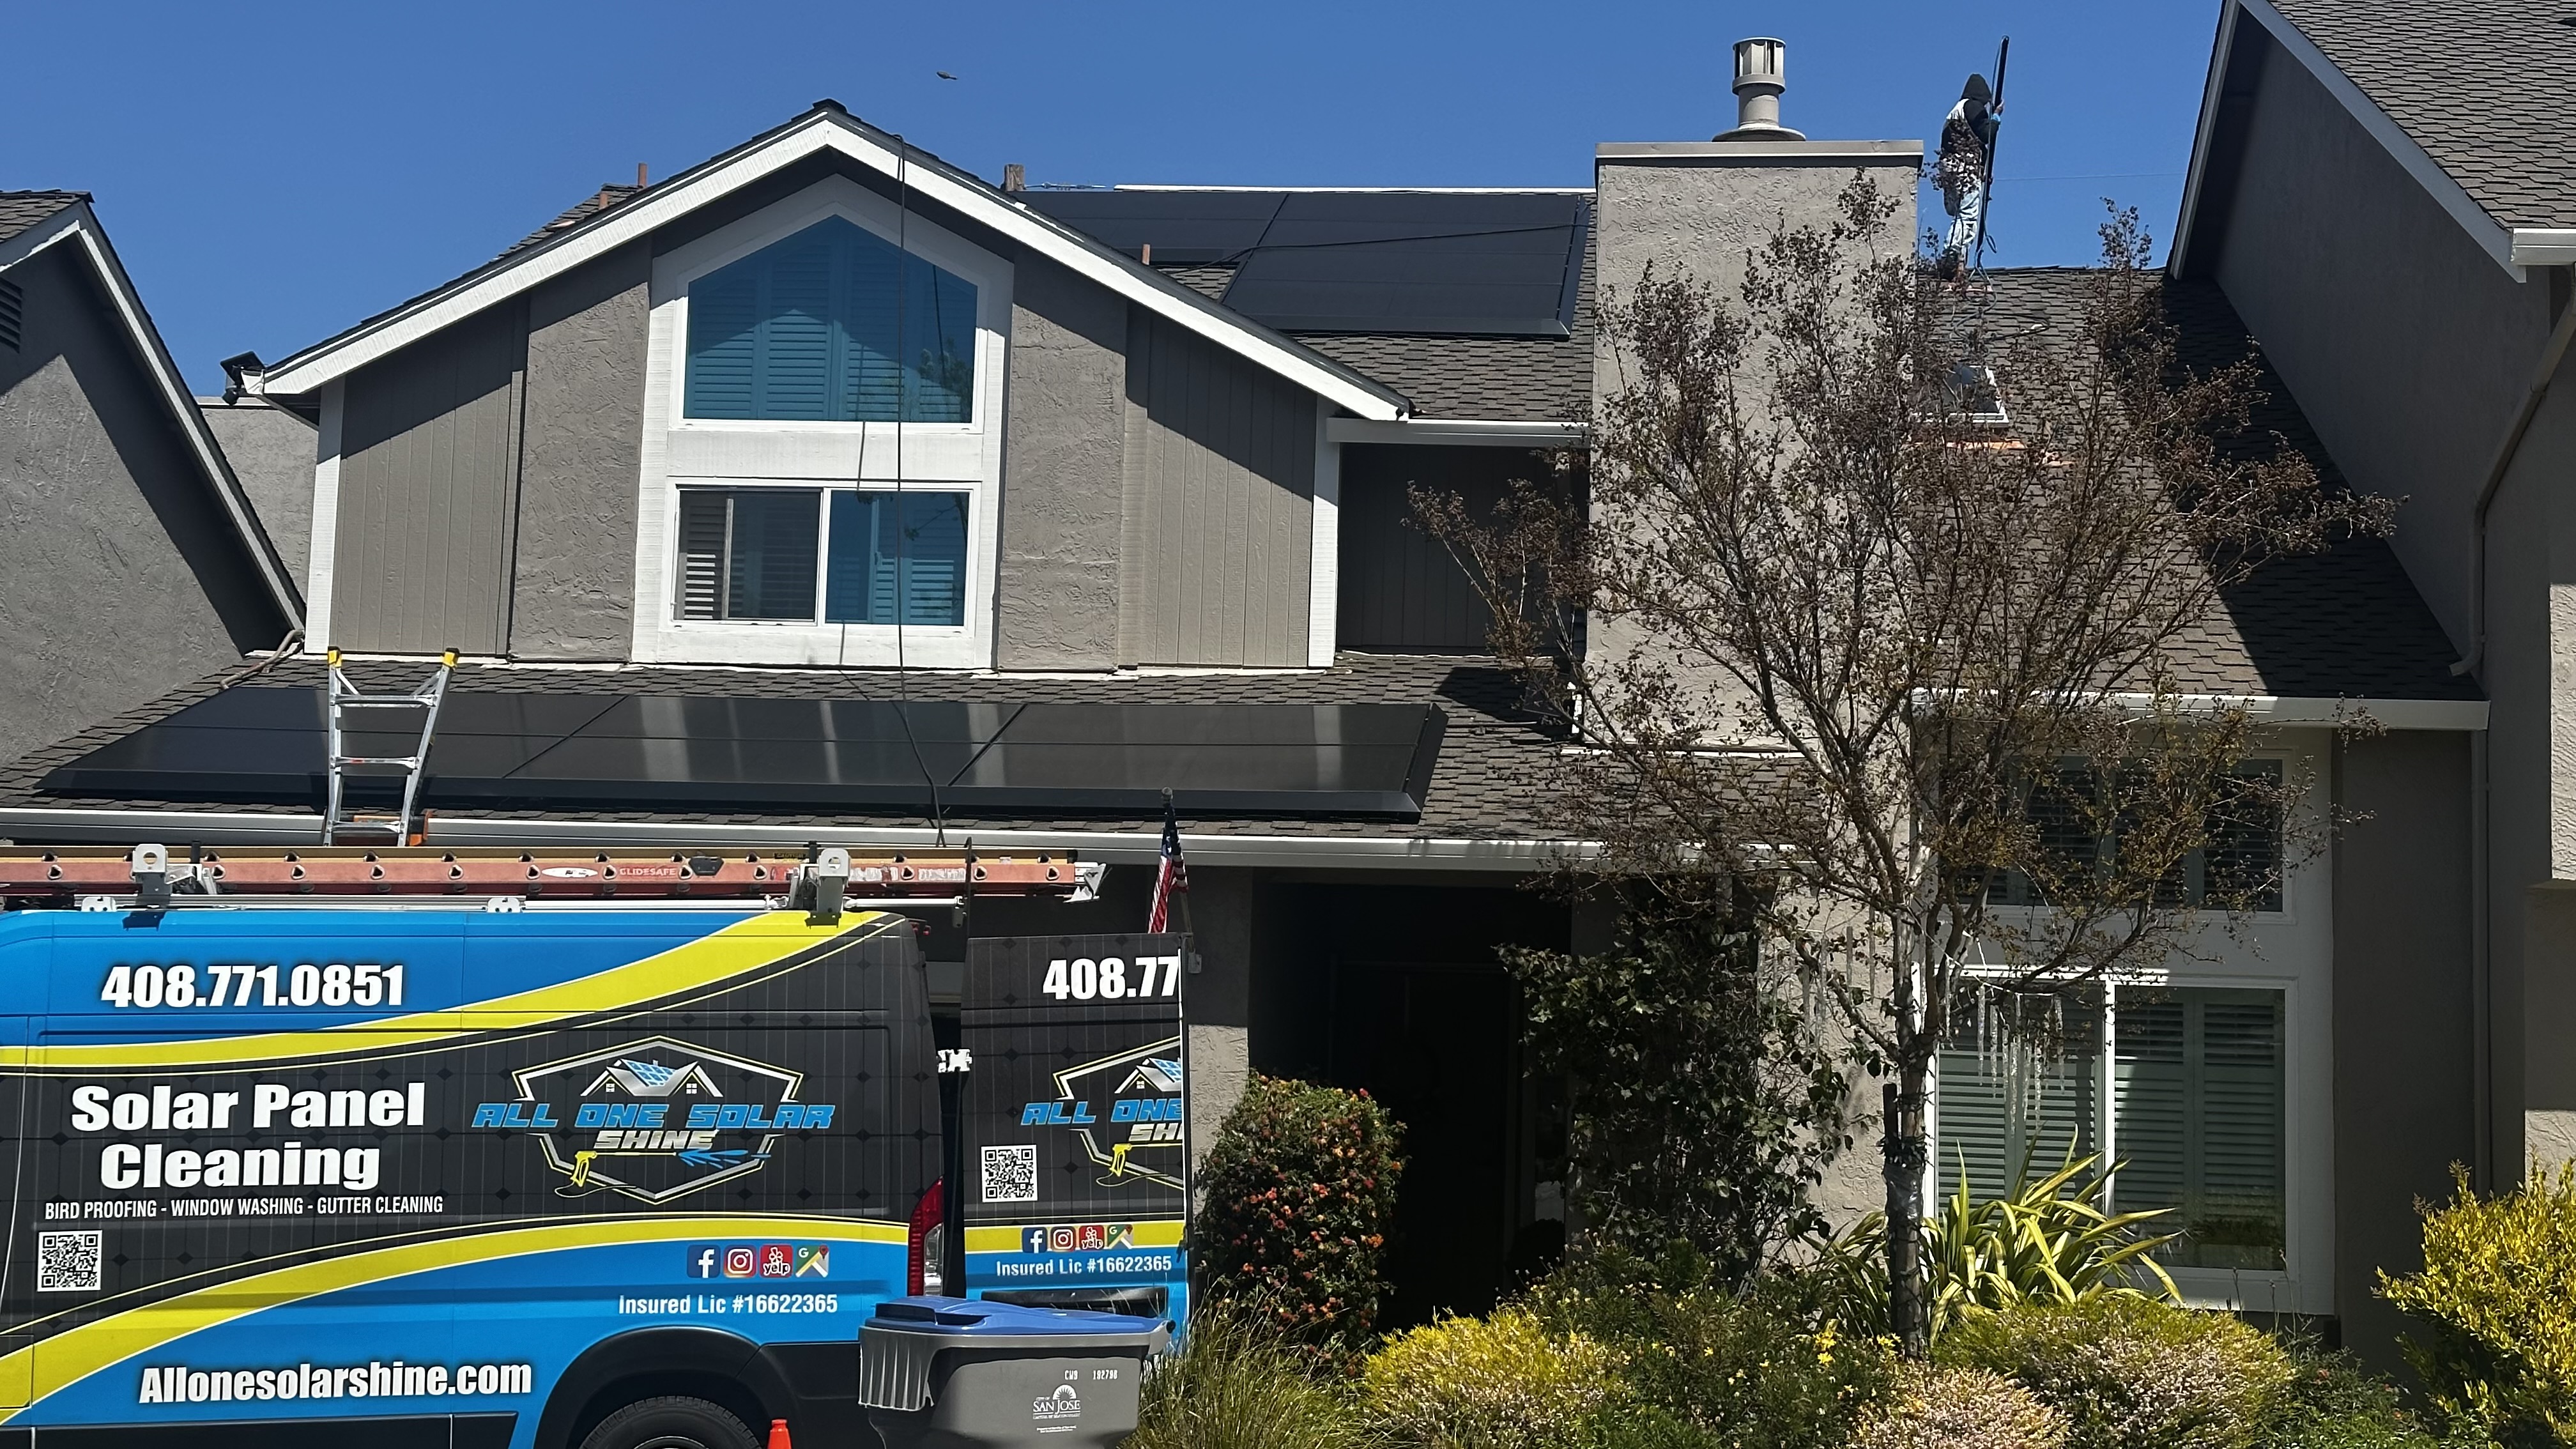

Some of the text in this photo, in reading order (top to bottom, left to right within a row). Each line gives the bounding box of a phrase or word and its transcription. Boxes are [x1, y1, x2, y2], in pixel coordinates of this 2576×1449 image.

[619, 868, 677, 877] GLIDESAFE
[100, 964, 403, 1008] 408.771.0851
[1043, 956, 1179, 1000] 408.77
[71, 1082, 425, 1131] Solar Panel
[471, 1103, 836, 1129] ALL ONE SOLAR
[1020, 1101, 1096, 1126] ALL
[594, 1129, 718, 1149] SHINE
[100, 1141, 380, 1191] Cleaning
[45, 1202, 80, 1220] BIRD
[84, 1200, 157, 1219] PROOFING
[171, 1199, 234, 1216] WINDOW
[238, 1197, 303, 1215] WASHING
[317, 1196, 371, 1214] GUTTER
[375, 1195, 443, 1213] CLEANING
[1082, 1238, 1104, 1250] yelp
[763, 1262, 790, 1276] yelp
[996, 1255, 1172, 1276] Insured Lic #16622365
[618, 1294, 838, 1314] Insured Lic #16622365
[139, 1361, 532, 1404] Allonesolarshine.com
[1033, 1399, 1081, 1414] SAN JOSE
